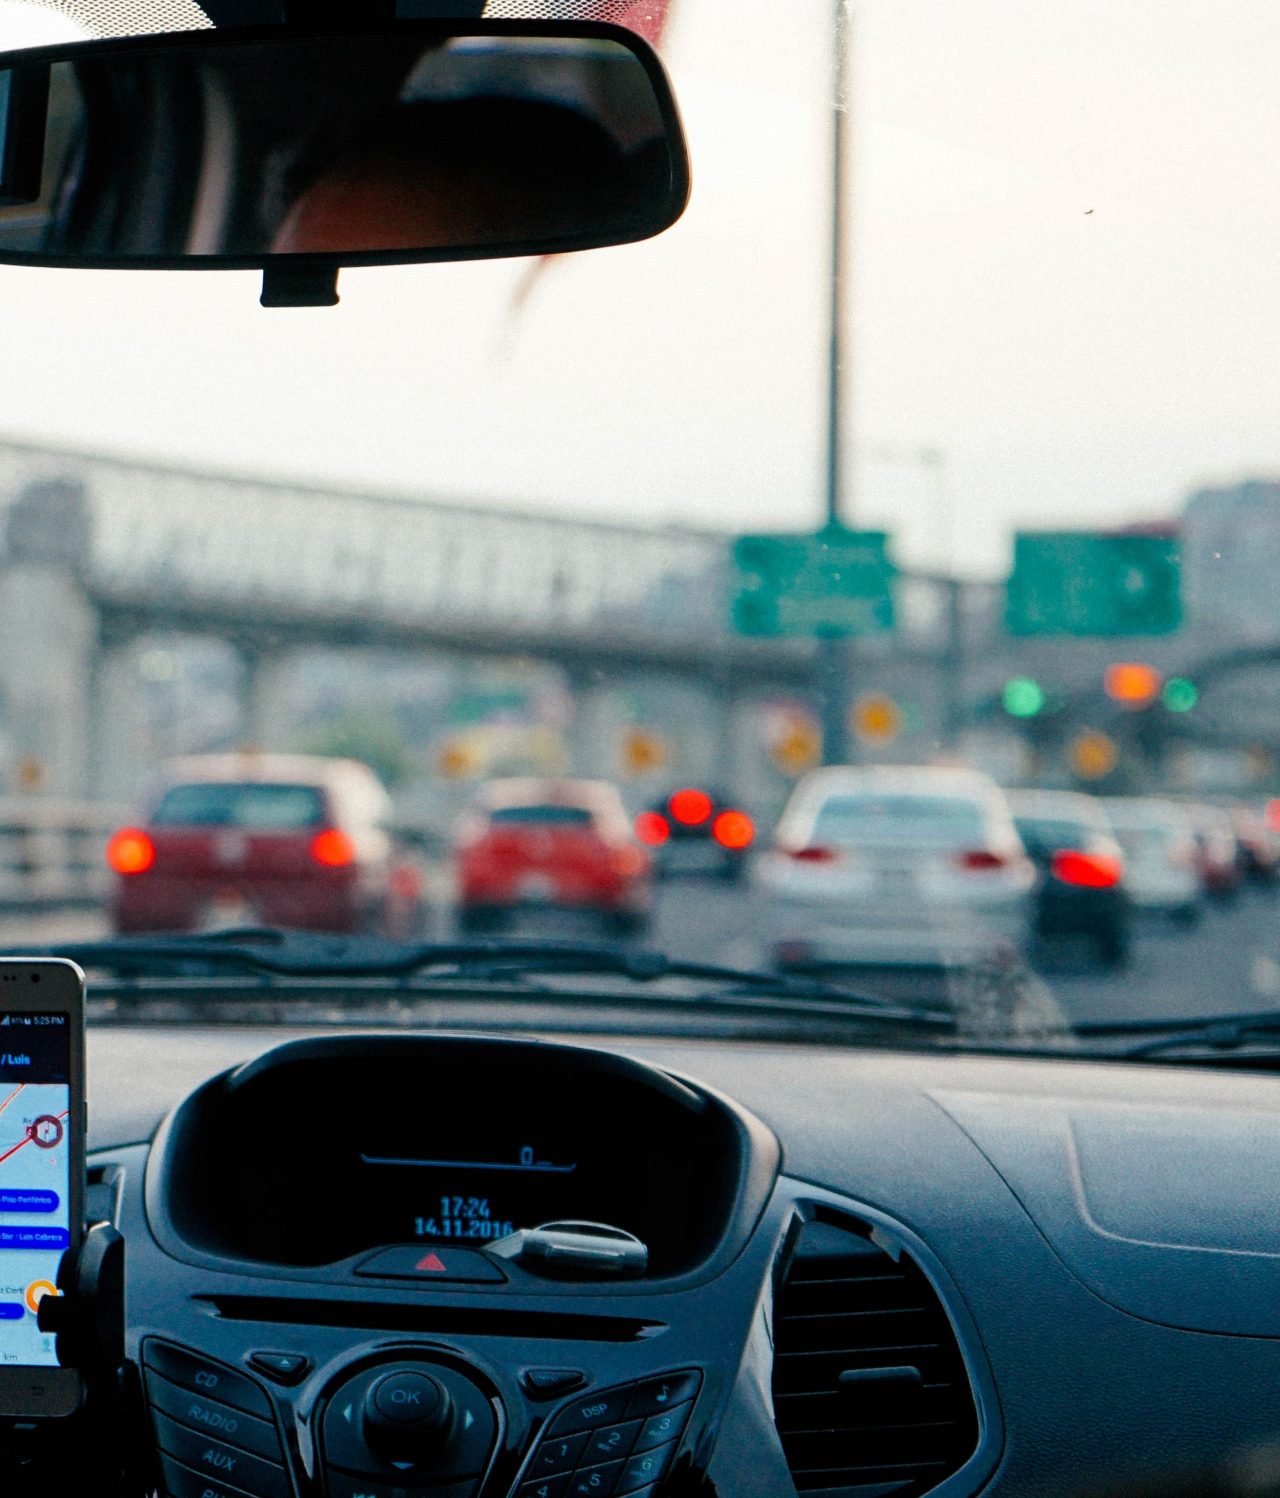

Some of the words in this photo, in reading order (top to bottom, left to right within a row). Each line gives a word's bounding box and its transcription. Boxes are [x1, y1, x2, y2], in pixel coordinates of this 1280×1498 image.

[51, 1017, 65, 1025] PM
[8, 1054, 31, 1065] Luis
[440, 1195, 490, 1218] 17:24
[4, 1352, 18, 1361] km
[194, 1371, 218, 1388] CD
[391, 1389, 421, 1404] OK
[582, 1403, 608, 1419] DSP
[188, 1405, 238, 1433] RADIO
[660, 1418, 671, 1430] 3
[608, 1432, 621, 1446] 2
[560, 1444, 568, 1457] 1
[202, 1449, 237, 1472] AUX
[642, 1458, 653, 1470] 6
[589, 1473, 601, 1487] 5
[537, 1485, 548, 1498] 4
